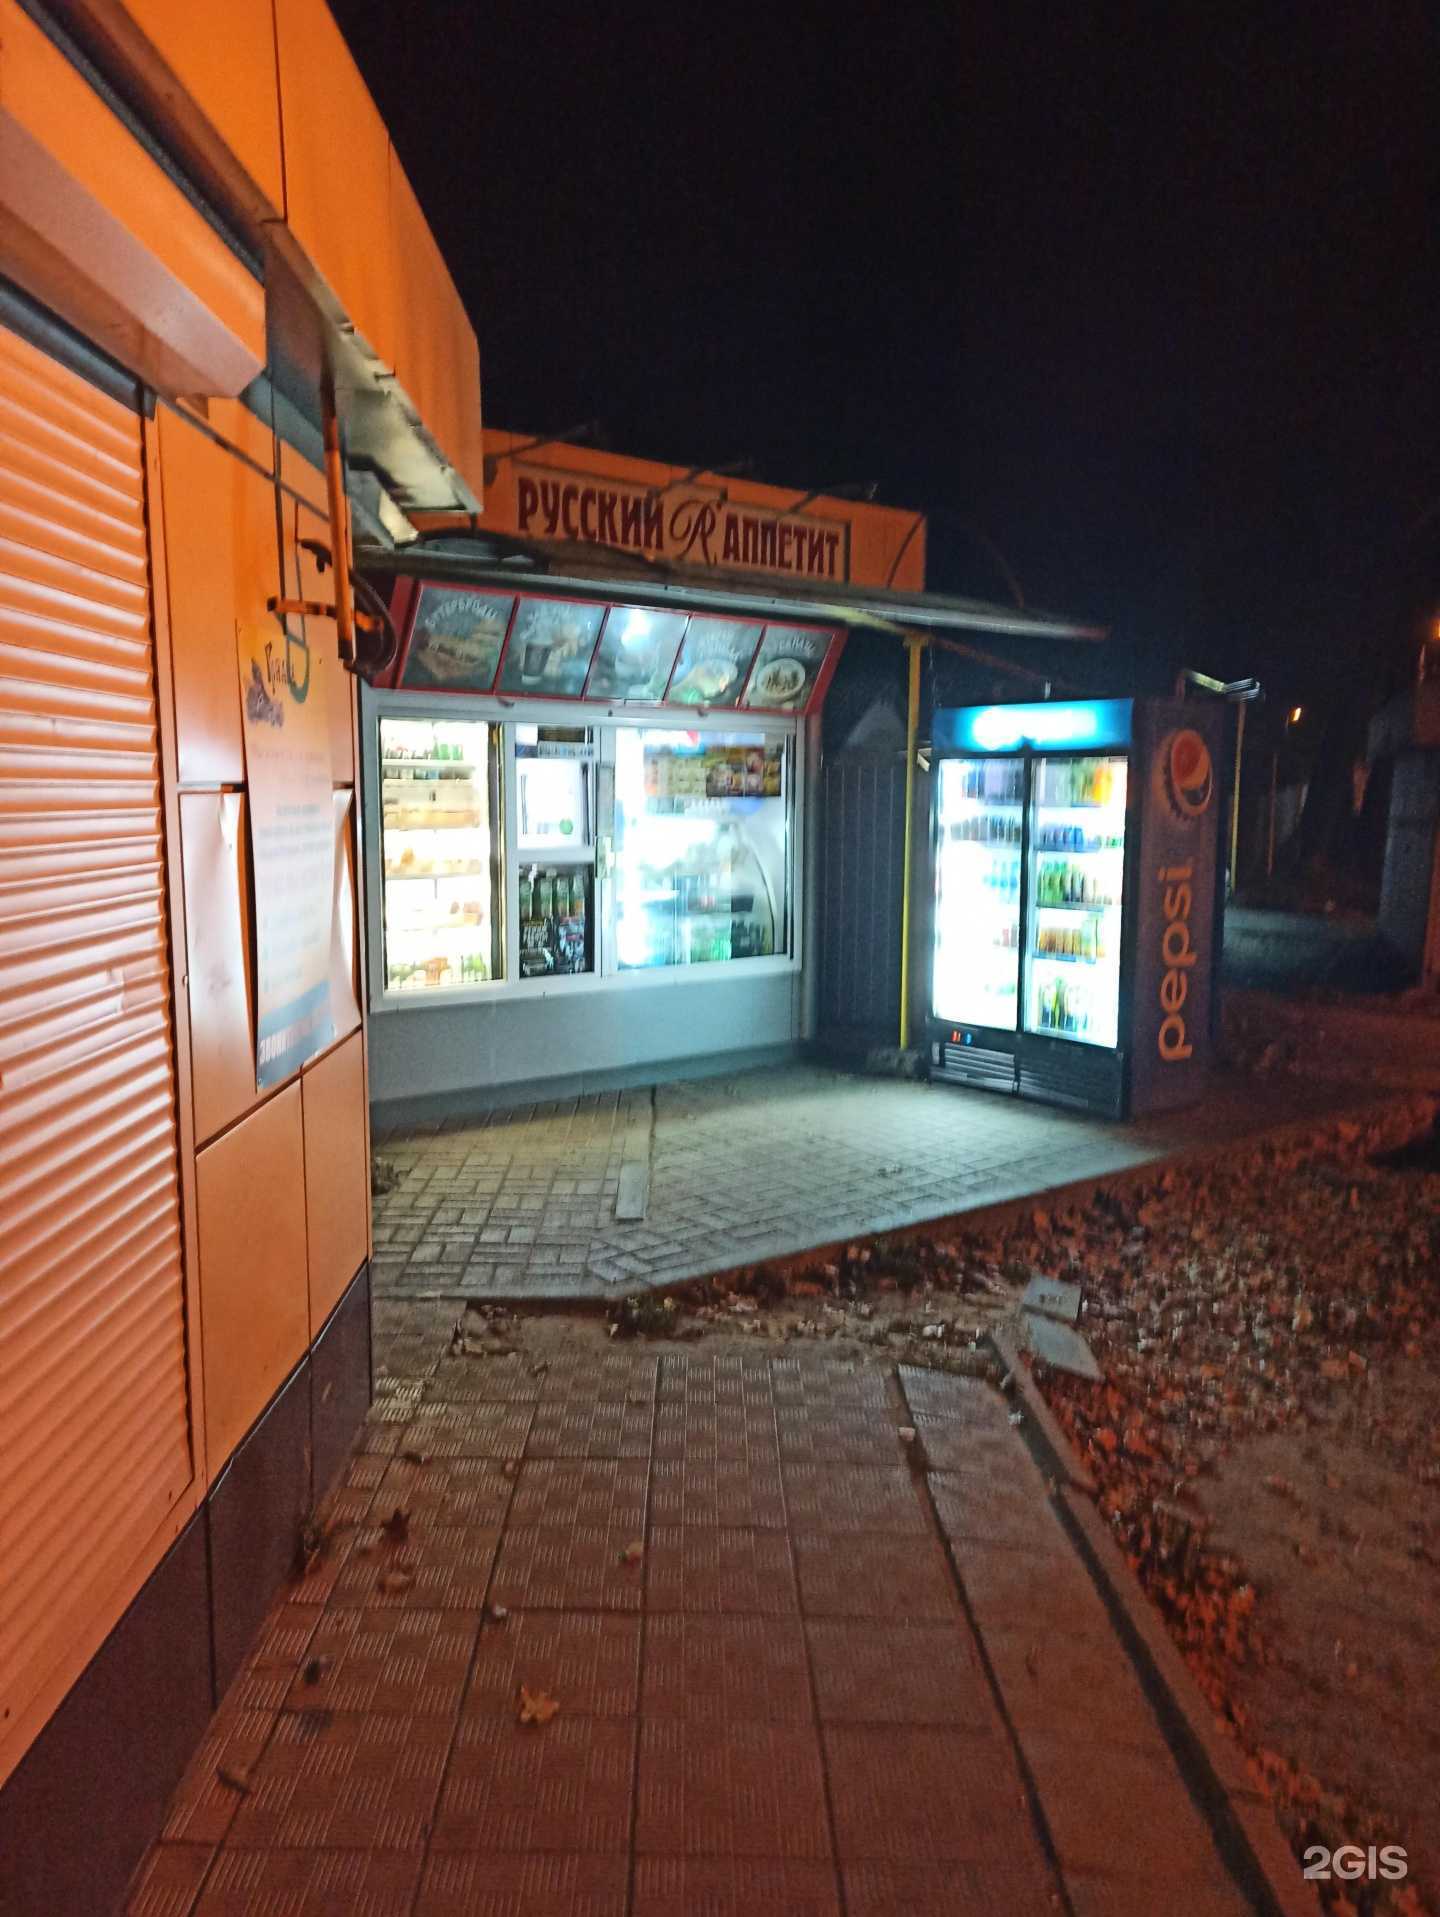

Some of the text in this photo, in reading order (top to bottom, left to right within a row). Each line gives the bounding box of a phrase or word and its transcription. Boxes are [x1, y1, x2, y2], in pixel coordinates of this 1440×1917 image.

[517, 476, 664, 551] РУССКИЙ
[722, 515, 840, 578] АППЕТИТ
[1158, 865, 1197, 1062] pepsi
